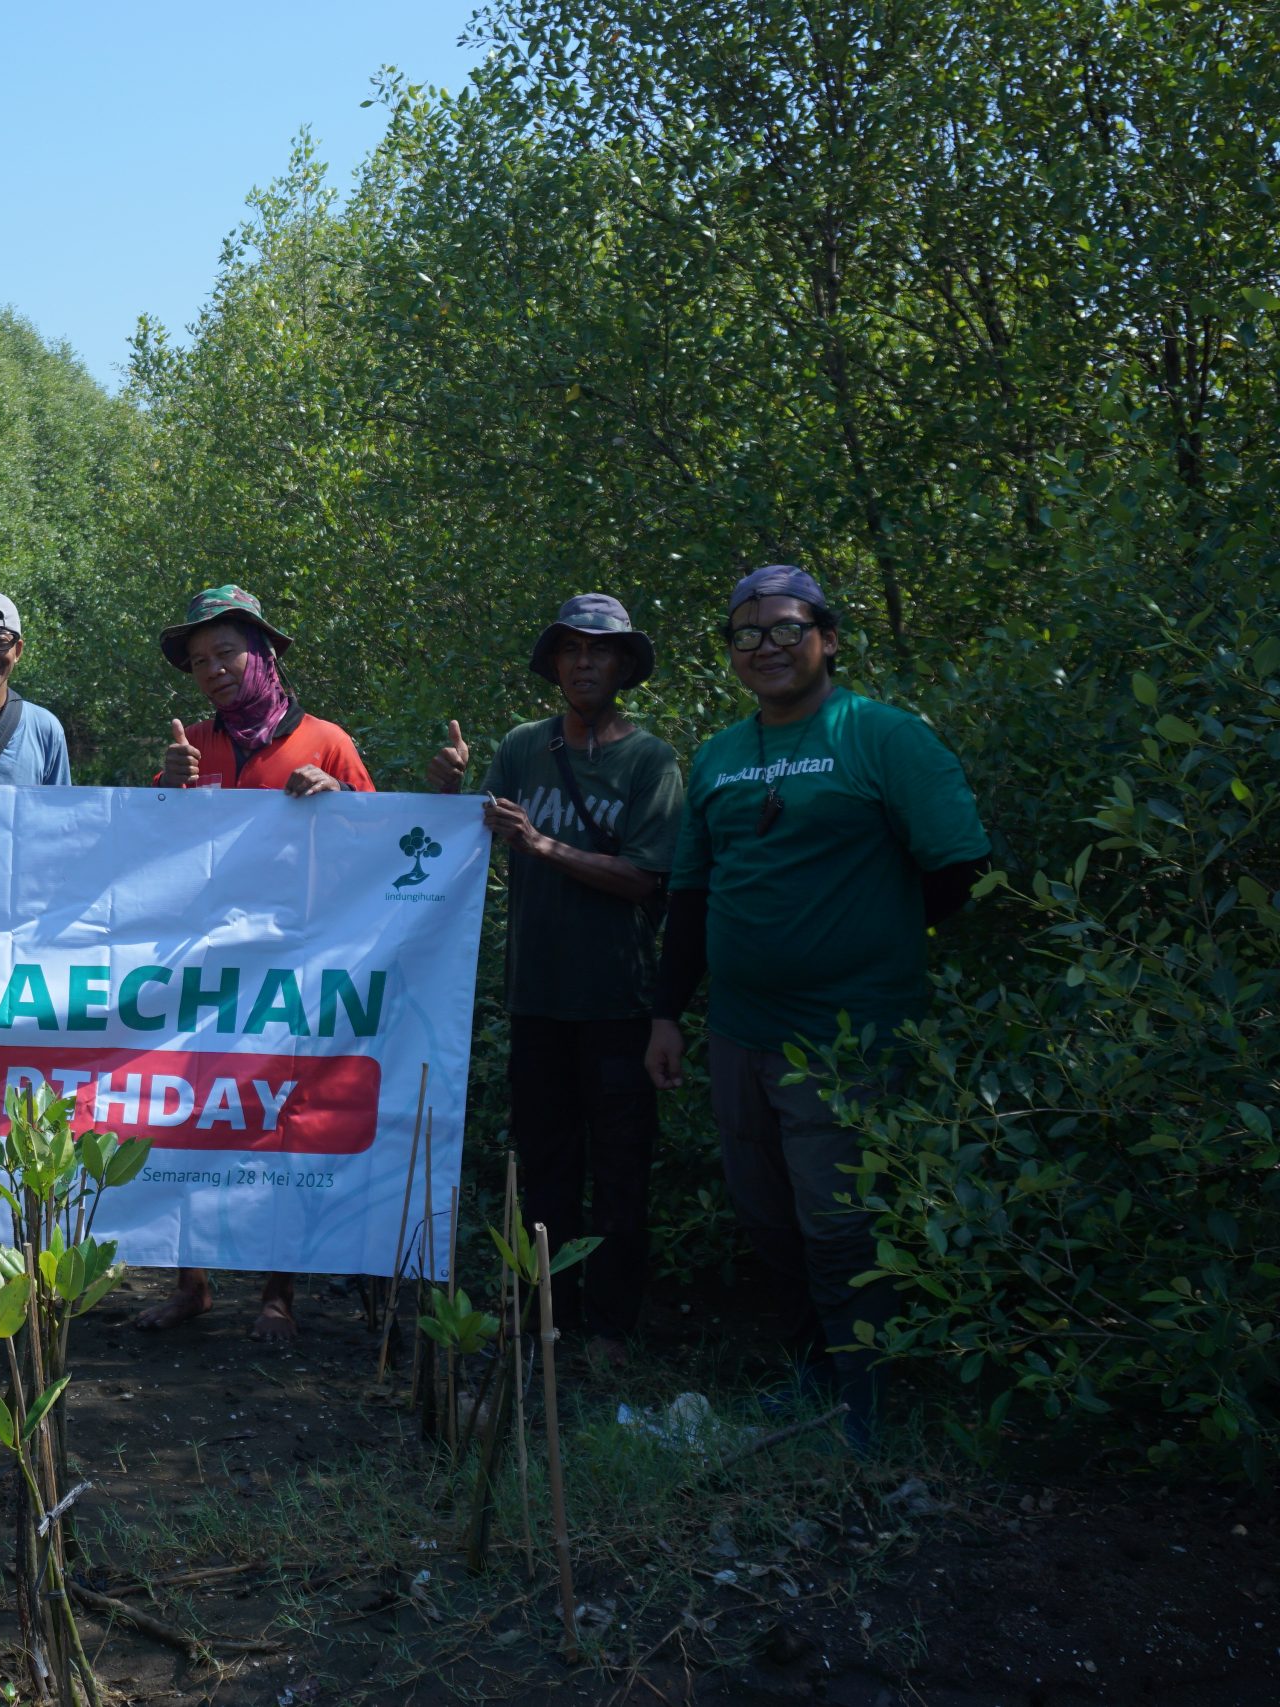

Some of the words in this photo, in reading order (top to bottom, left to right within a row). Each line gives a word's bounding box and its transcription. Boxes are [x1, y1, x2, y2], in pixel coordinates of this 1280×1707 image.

[714, 757, 834, 785] lindungihutan
[385, 892, 446, 903] lindungihutan
[142, 1167, 221, 1187] Semarang
[236, 1170, 256, 1185] 28
[262, 1172, 291, 1187] Mei
[296, 1173, 335, 1188] 2023
